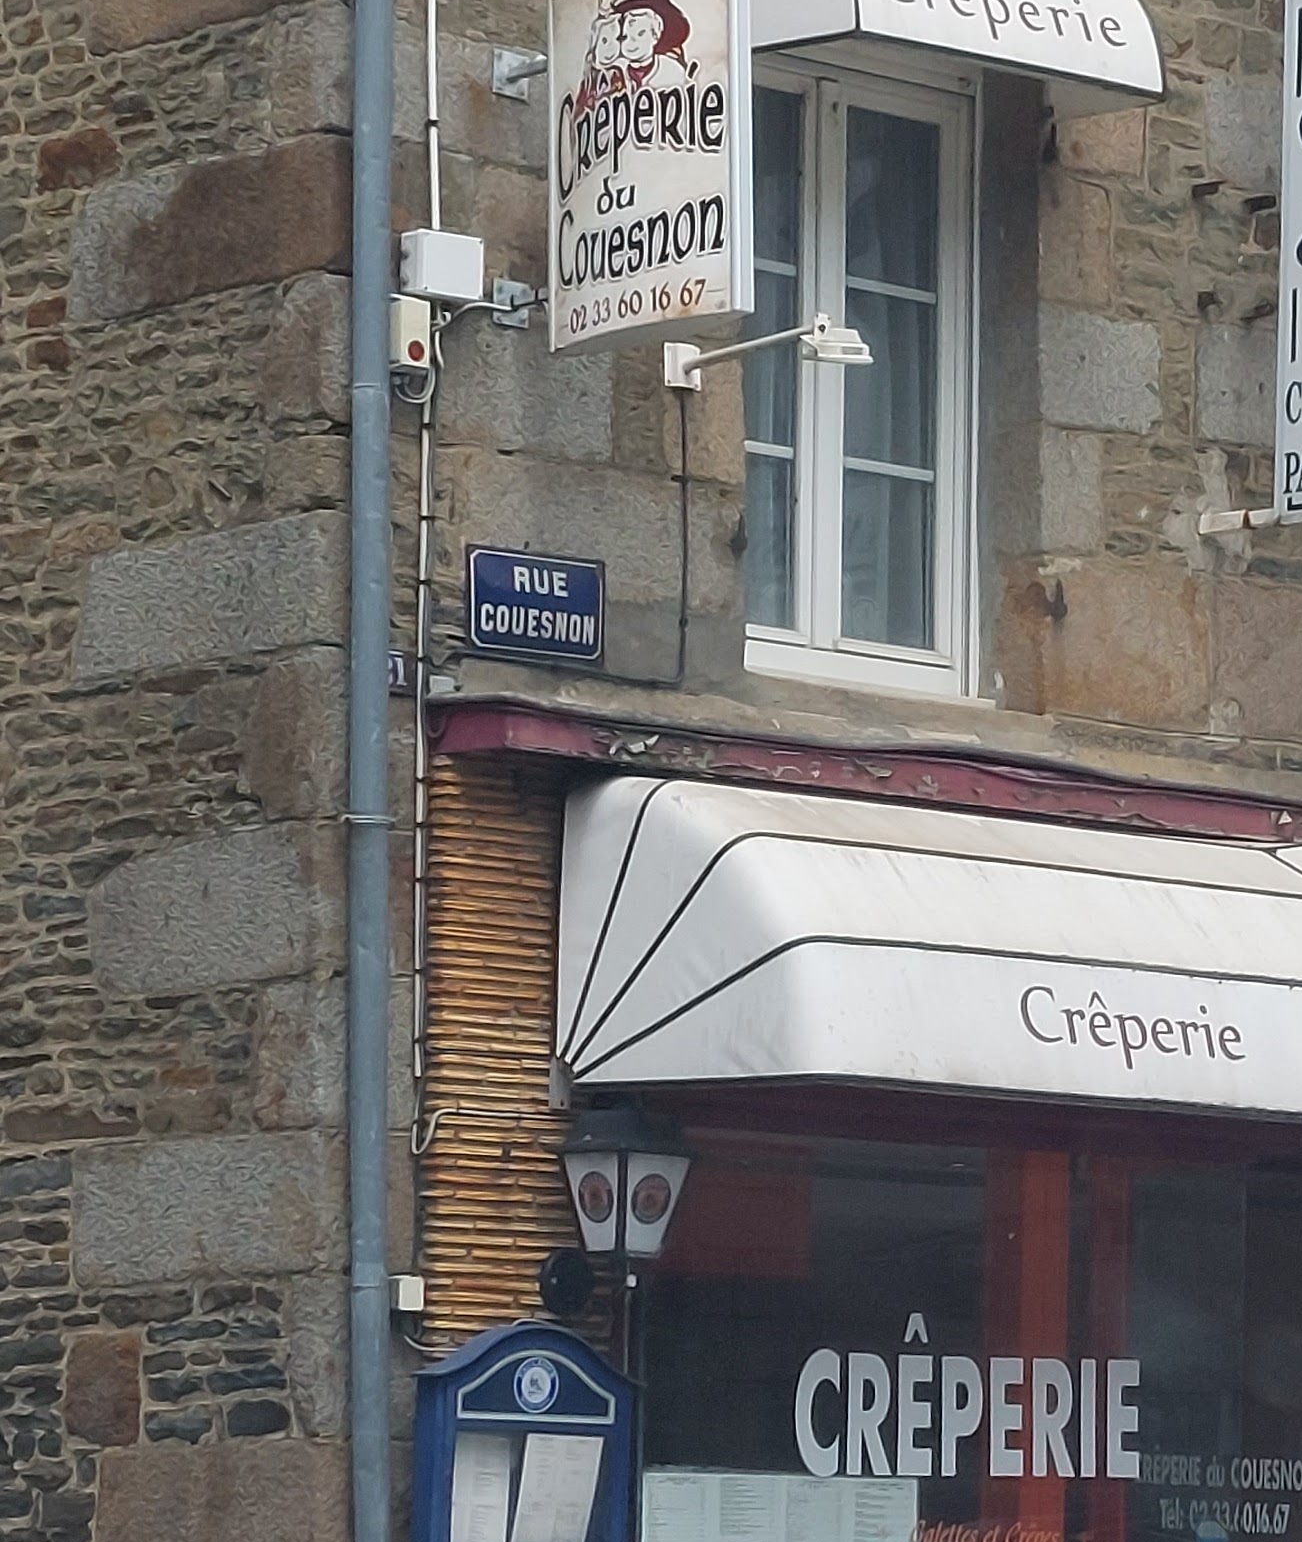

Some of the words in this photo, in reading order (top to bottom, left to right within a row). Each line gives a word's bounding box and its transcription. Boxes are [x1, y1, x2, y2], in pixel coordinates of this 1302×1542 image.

[597, 177, 636, 215] du
[559, 195, 725, 287] Couesnon
[570, 307, 587, 334] 02
[592, 297, 611, 326] 33
[618, 289, 643, 319] 60
[650, 282, 671, 312] 16
[679, 277, 707, 306] 67
[513, 565, 569, 598] RUE
[480, 603, 595, 646] COUESNON
[1020, 985, 1247, 1070] Crêperie
[795, 1312, 1141, 1478] CRÊPERIE
[1137, 1444, 1201, 1486] RÊPERIE
